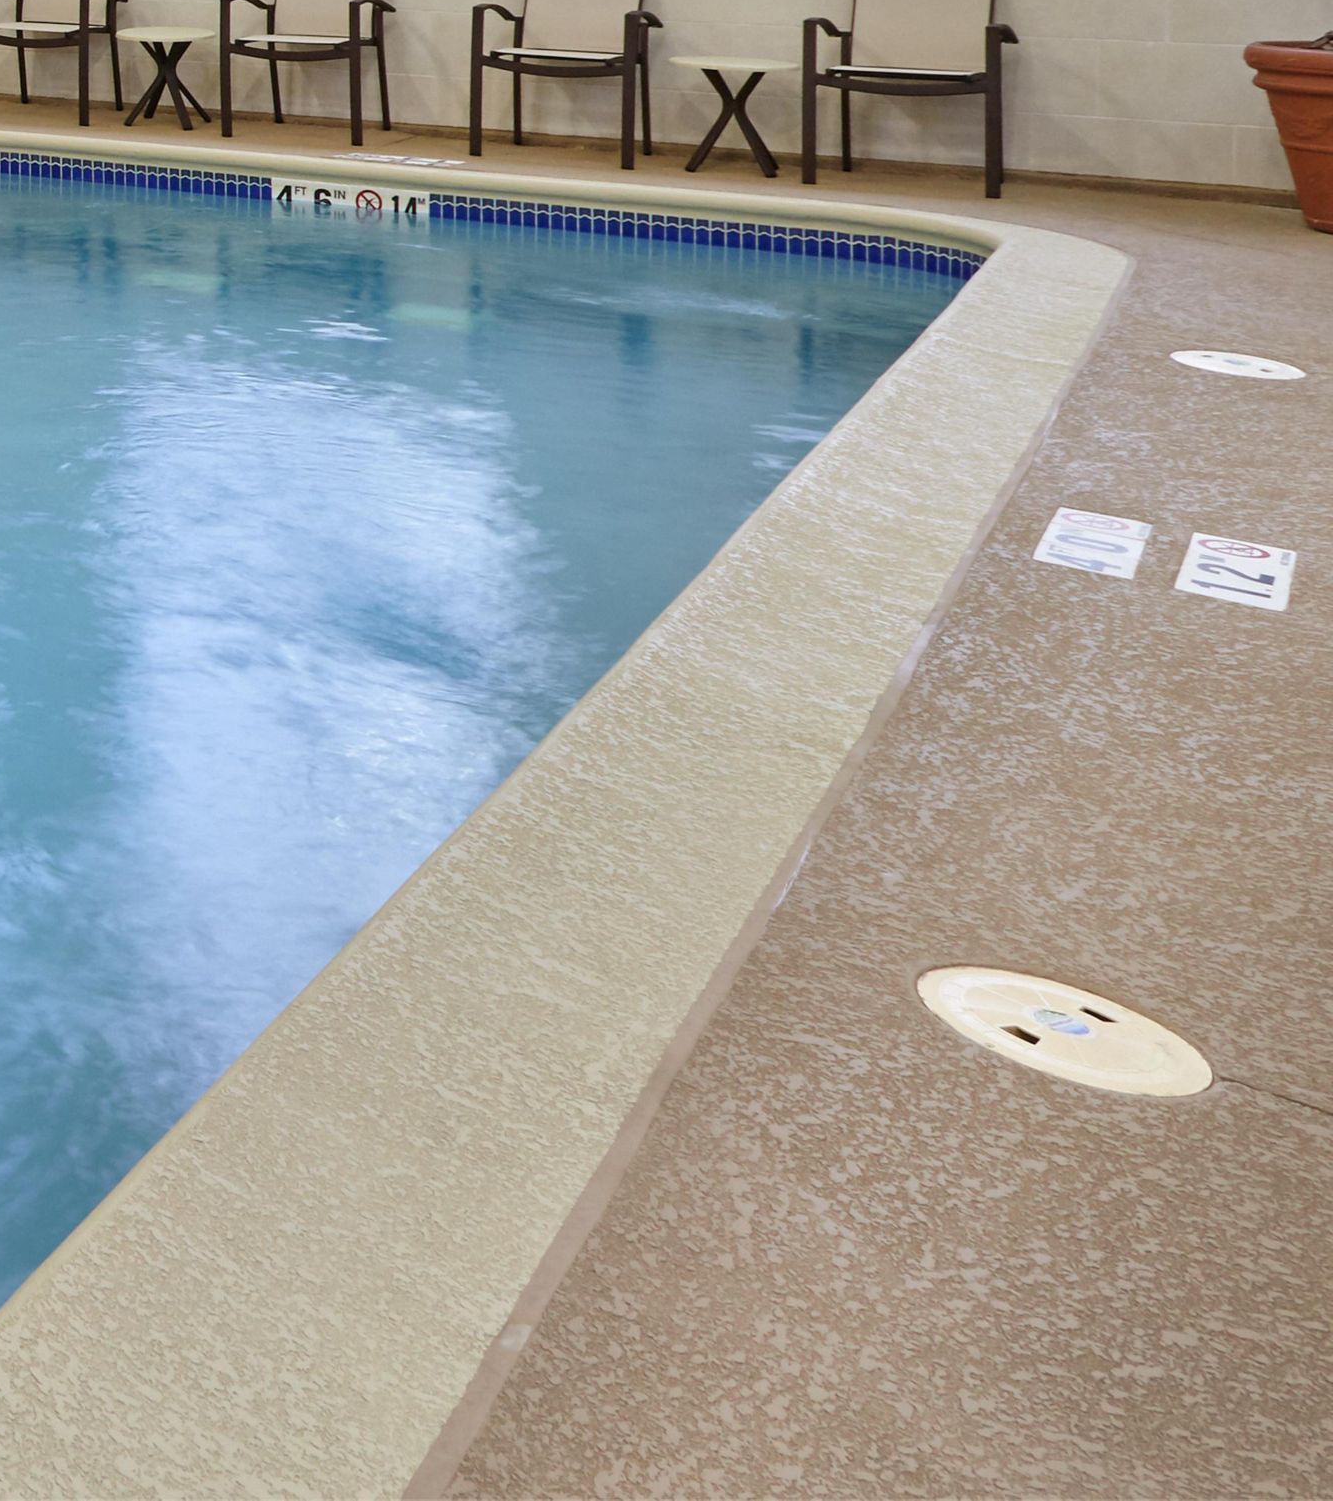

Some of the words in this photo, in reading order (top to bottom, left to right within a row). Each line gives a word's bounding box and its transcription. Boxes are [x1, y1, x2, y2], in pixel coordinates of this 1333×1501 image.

[276, 185, 293, 202] 4
[295, 186, 307, 196] FT
[314, 188, 332, 206] 6
[334, 190, 346, 200] IN
[1046, 551, 1123, 573] 4
